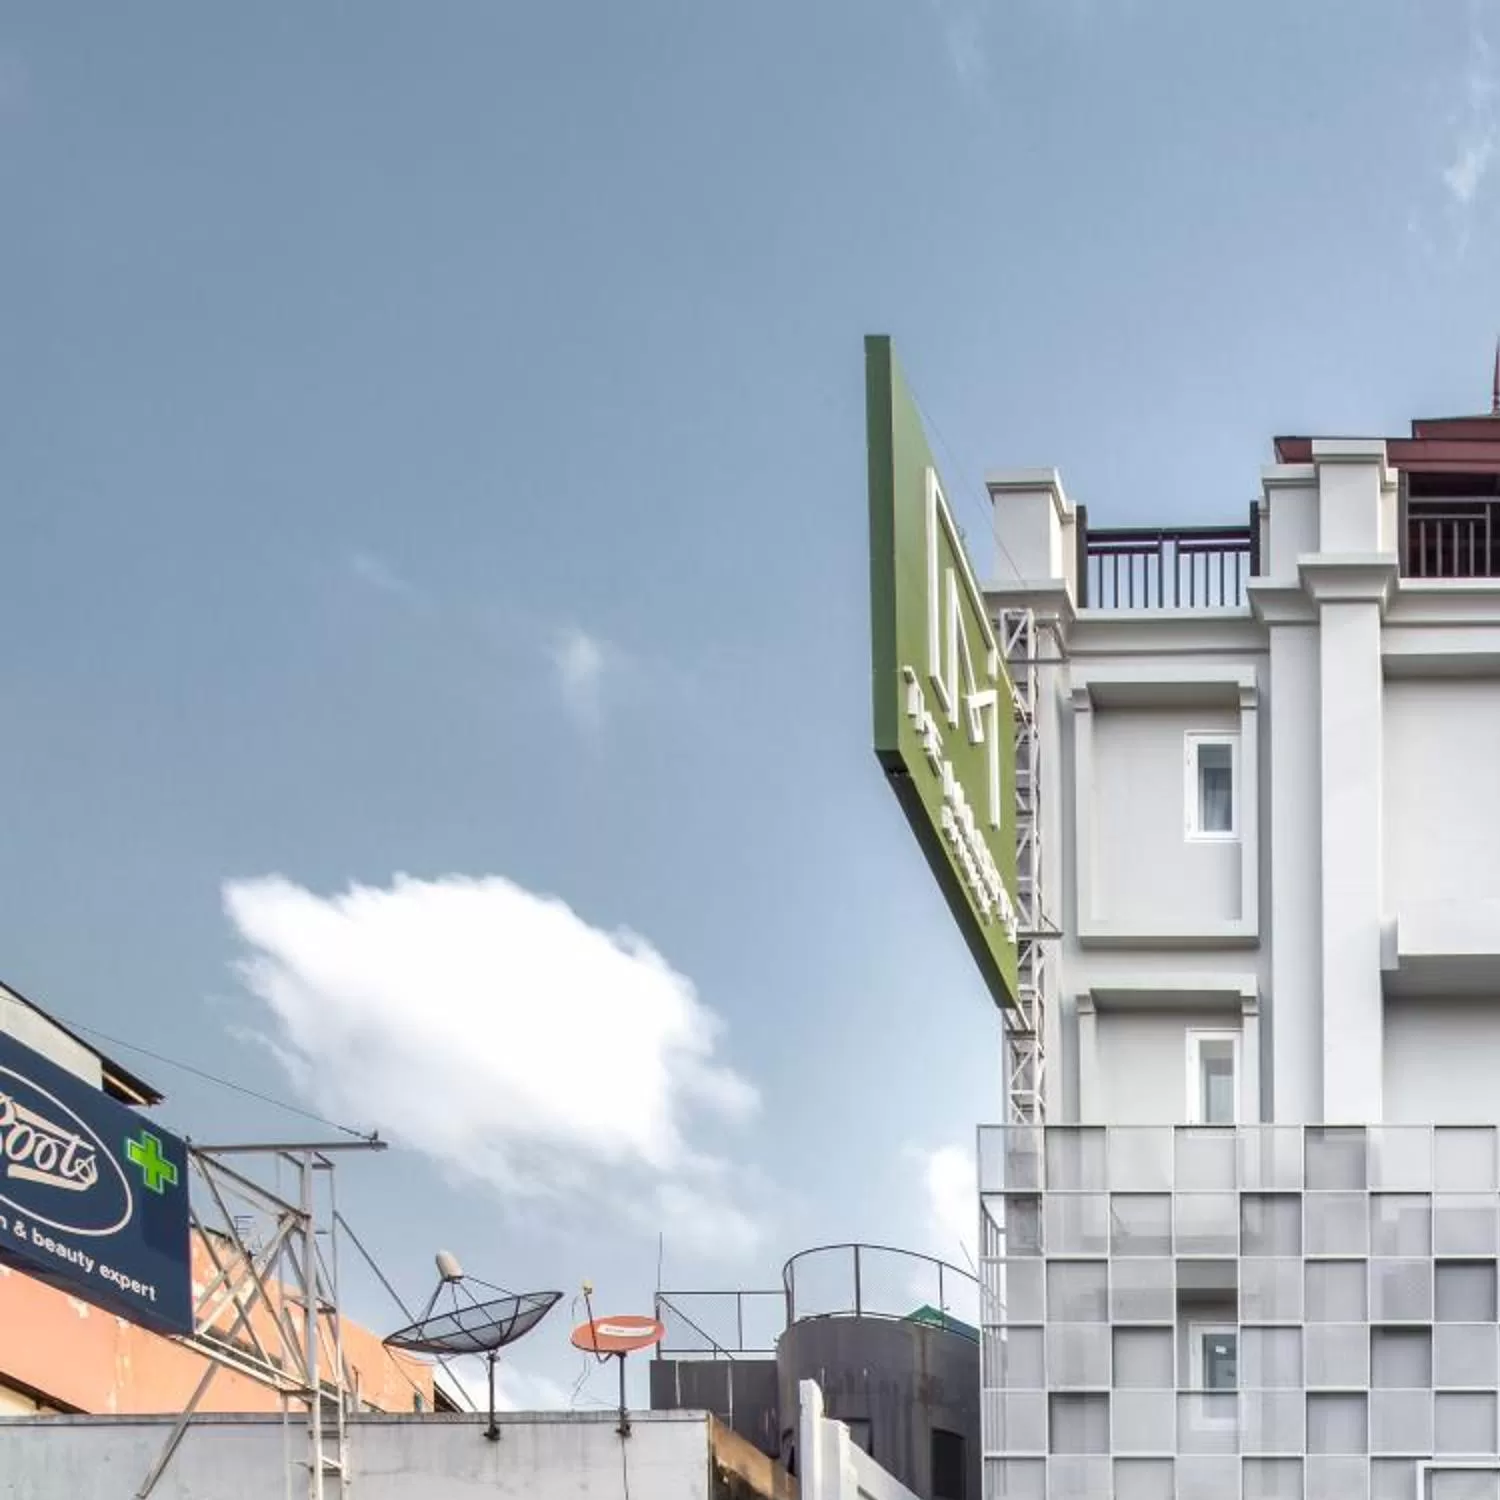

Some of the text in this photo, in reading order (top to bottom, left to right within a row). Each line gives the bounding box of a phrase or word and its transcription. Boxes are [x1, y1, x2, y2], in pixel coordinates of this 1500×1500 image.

[13, 1221, 28, 1241] &
[32, 1227, 95, 1273] beauty
[99, 1264, 157, 1301] expert
